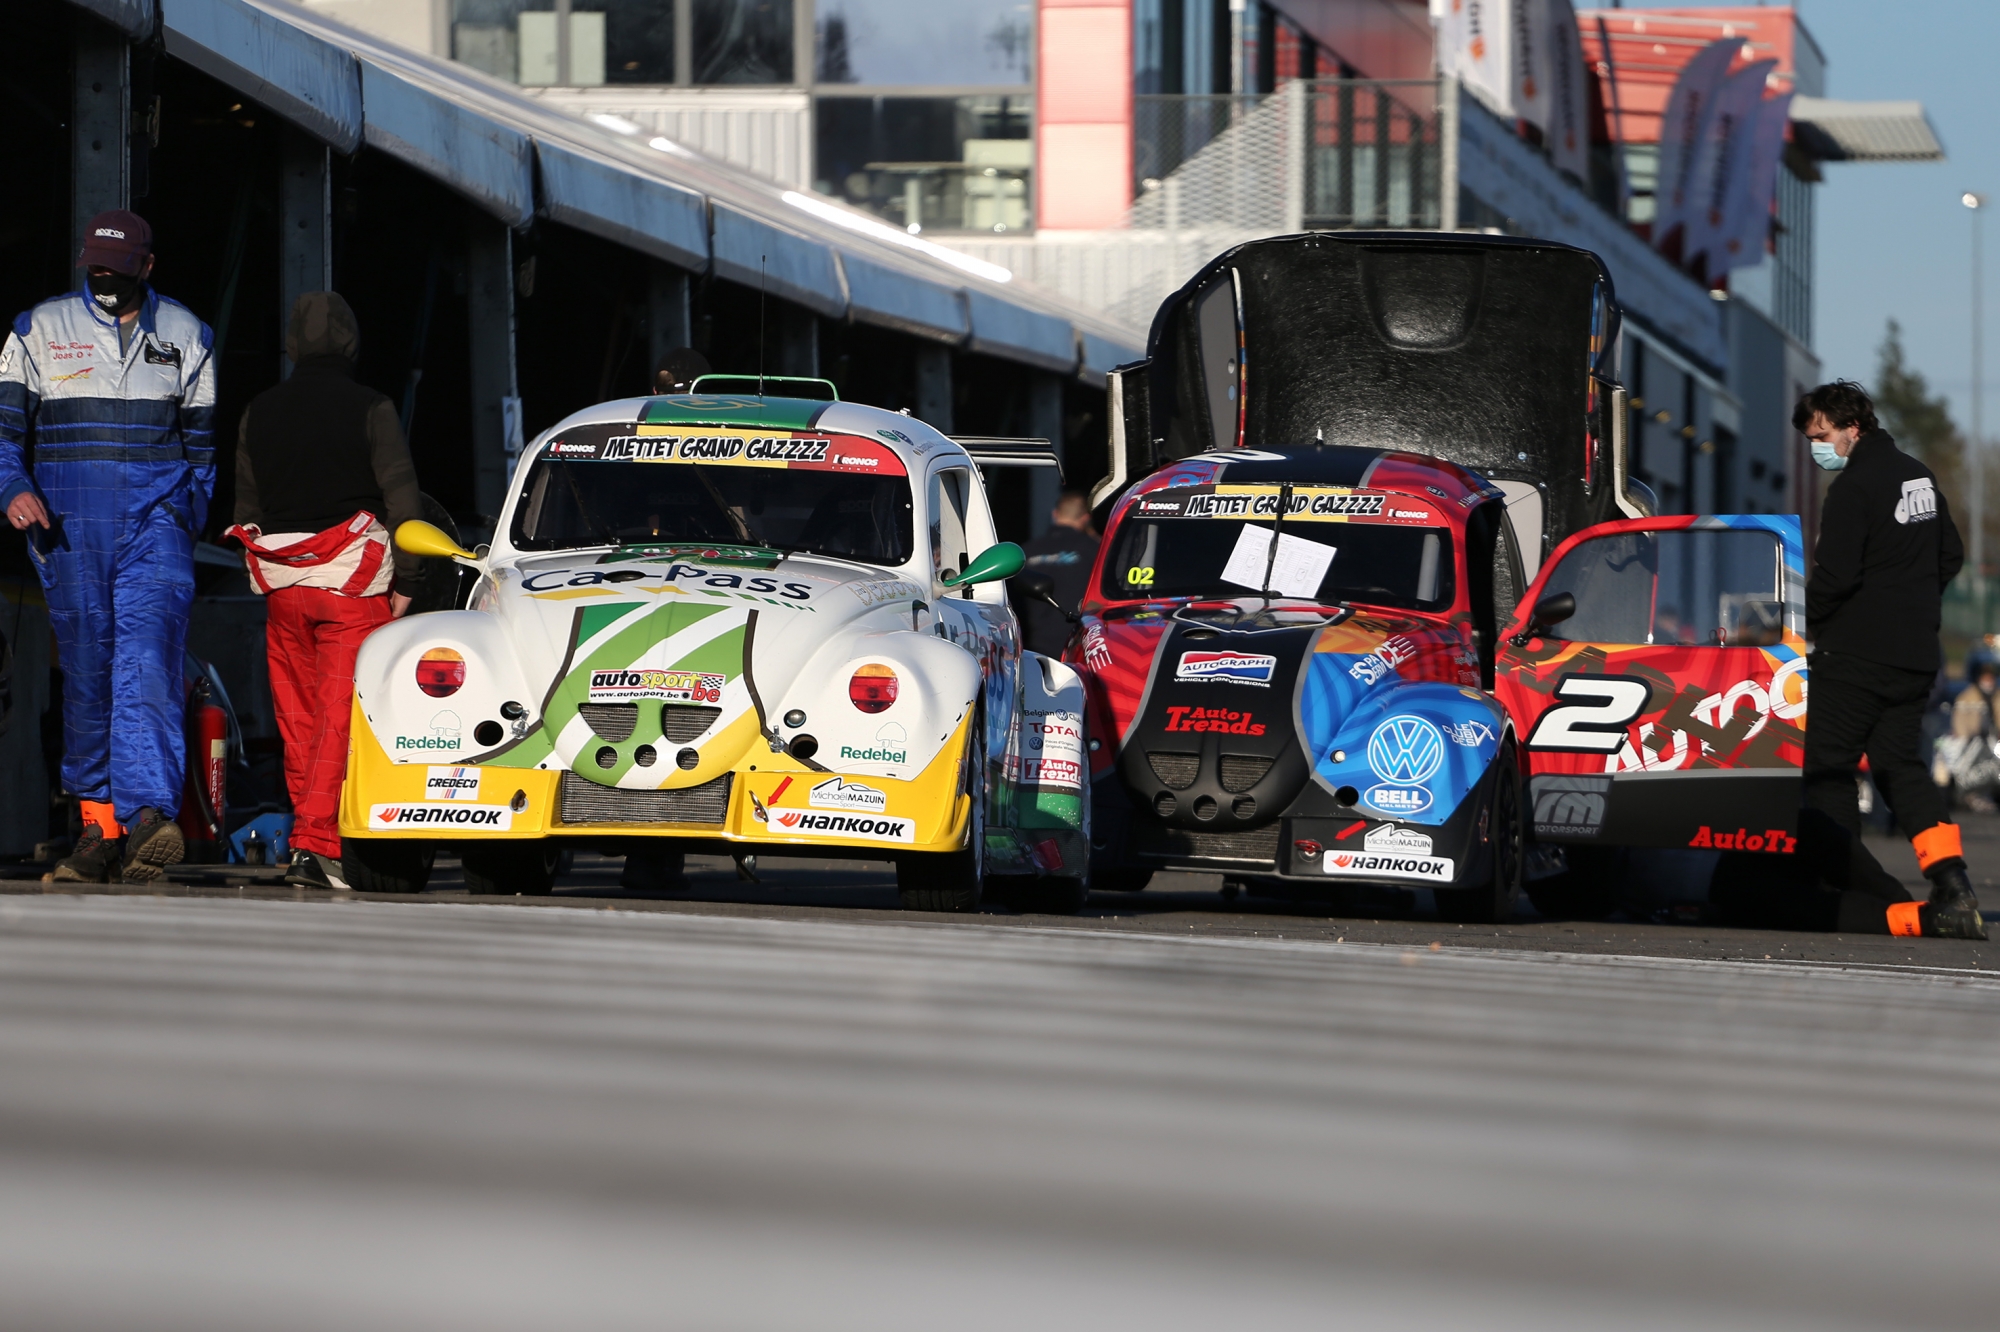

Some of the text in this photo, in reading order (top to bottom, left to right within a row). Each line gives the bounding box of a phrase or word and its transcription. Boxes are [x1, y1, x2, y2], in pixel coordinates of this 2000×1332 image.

[550, 440, 596, 453] KRONOS
[601, 435, 830, 462] METTET GRAND GAZZZZ
[832, 452, 878, 467] KRONOS
[1139, 499, 1180, 511] KRONOS
[1184, 493, 1386, 517] METTET GRND GAZZZZ
[1387, 508, 1428, 519] KRONOS
[521, 563, 812, 600] Ca-Pass
[1127, 566, 1154, 585] 02
[1182, 659, 1273, 672] AUTOGRAPHE
[592, 670, 702, 689] autosport
[1210, 676, 1271, 688] CONVERSIONS
[590, 691, 679, 699] www.autosport.be
[1024, 710, 1055, 718] Belgian
[1190, 707, 1240, 720] Auto
[1528, 677, 1648, 750] 2
[1164, 706, 1266, 736] Trends
[1028, 722, 1082, 741] TOTAL
[396, 736, 461, 749] Redebel
[840, 746, 907, 763] Redebel
[1042, 760, 1073, 771] Auto
[427, 778, 478, 788] CREDECO
[1374, 789, 1423, 805] BELL
